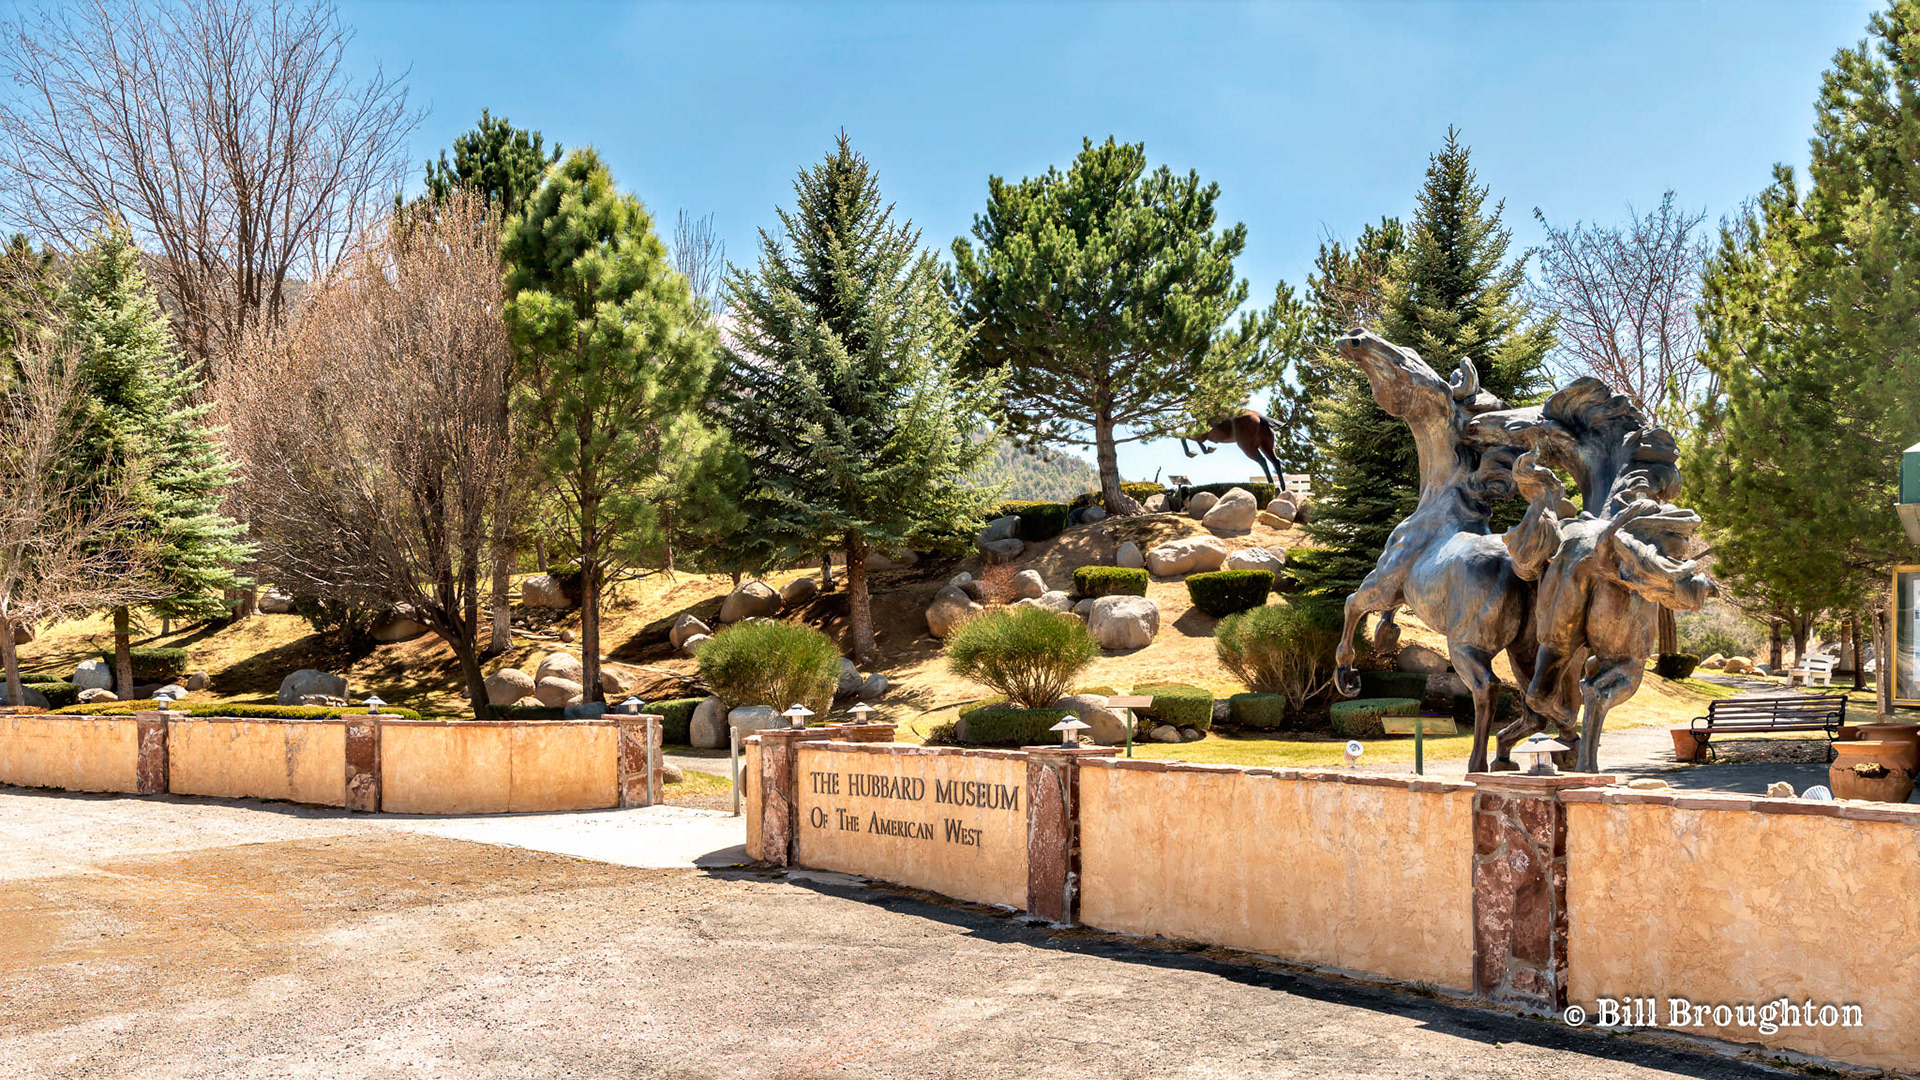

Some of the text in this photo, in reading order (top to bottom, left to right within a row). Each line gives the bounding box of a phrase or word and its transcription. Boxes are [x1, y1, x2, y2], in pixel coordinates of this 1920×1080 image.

[810, 771, 1020, 811] THE HUBBARD MUSEUM
[810, 806, 983, 848] OF THE AMERICAN WEST
